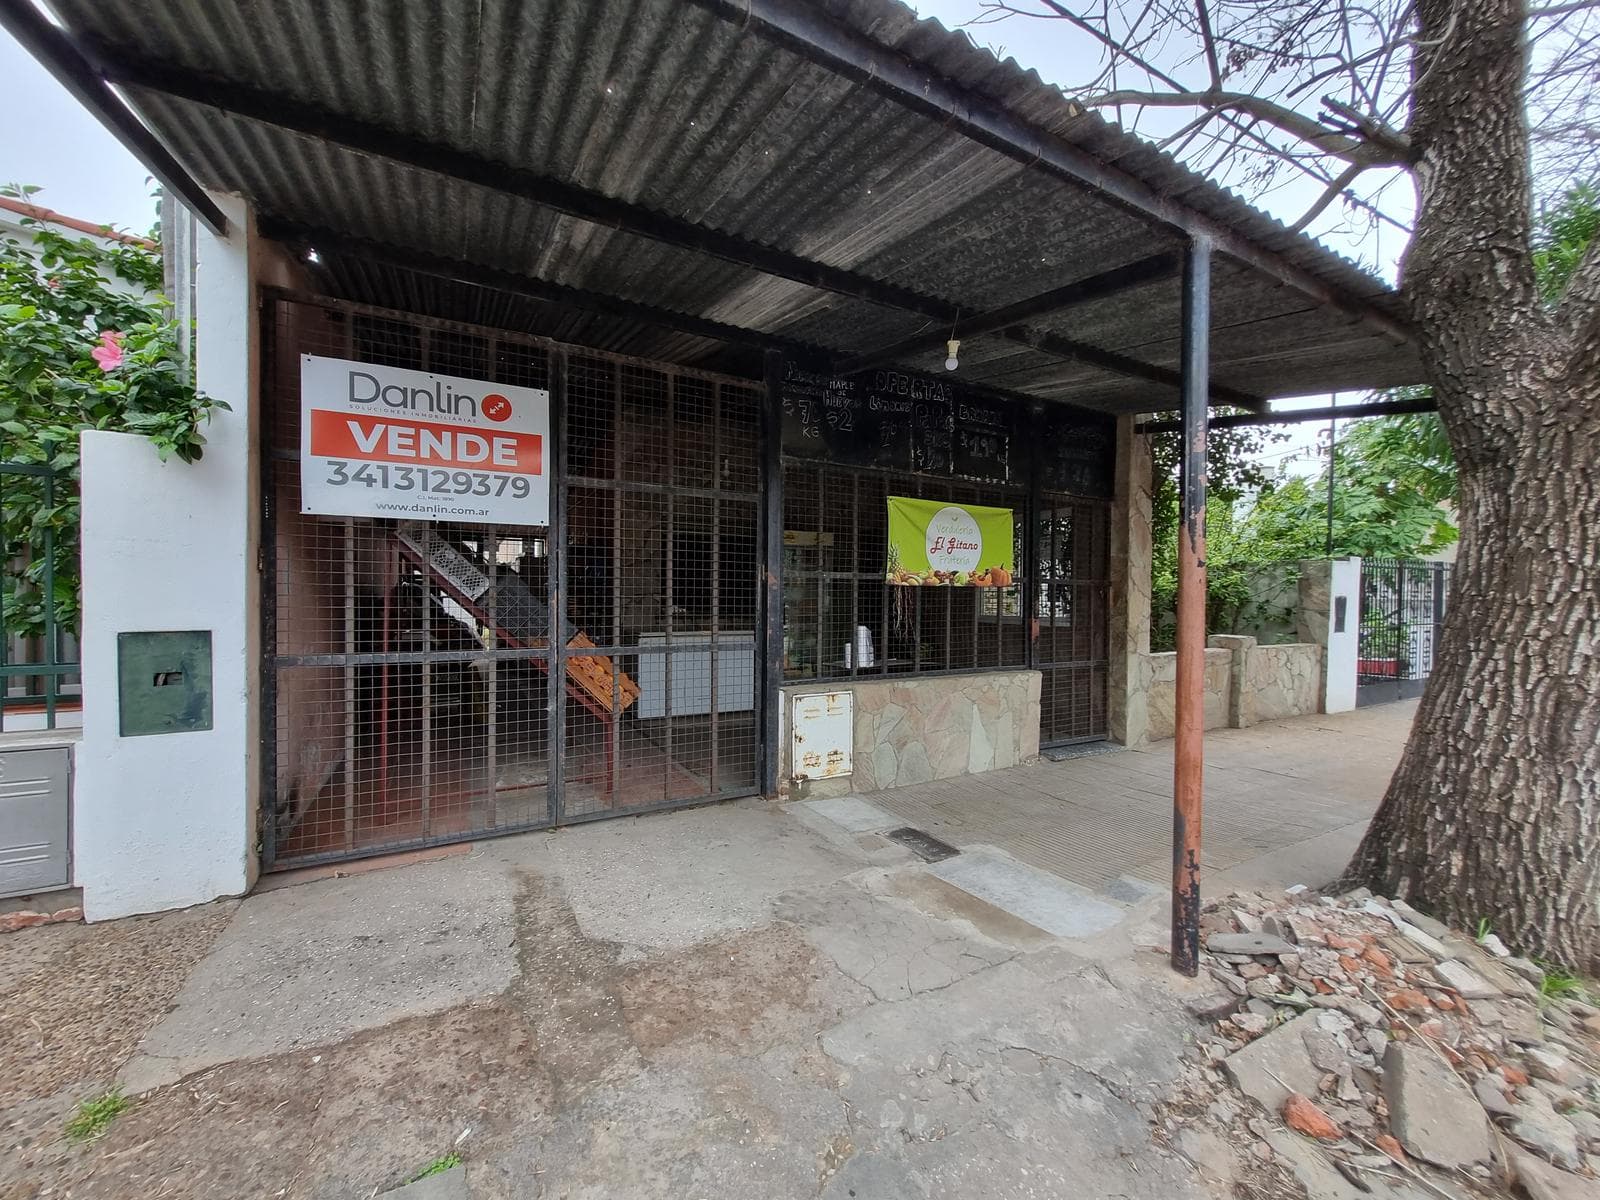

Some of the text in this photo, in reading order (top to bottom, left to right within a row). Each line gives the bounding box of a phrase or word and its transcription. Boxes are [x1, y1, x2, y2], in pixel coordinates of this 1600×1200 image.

[349, 371, 477, 417] Danlin
[349, 404, 406, 416] SOLUCIONES
[346, 420, 518, 467] VENDE
[326, 460, 531, 499] 3413129379
[376, 502, 490, 517] www.danlin.com.ar
[930, 536, 978, 555] El Gitano
